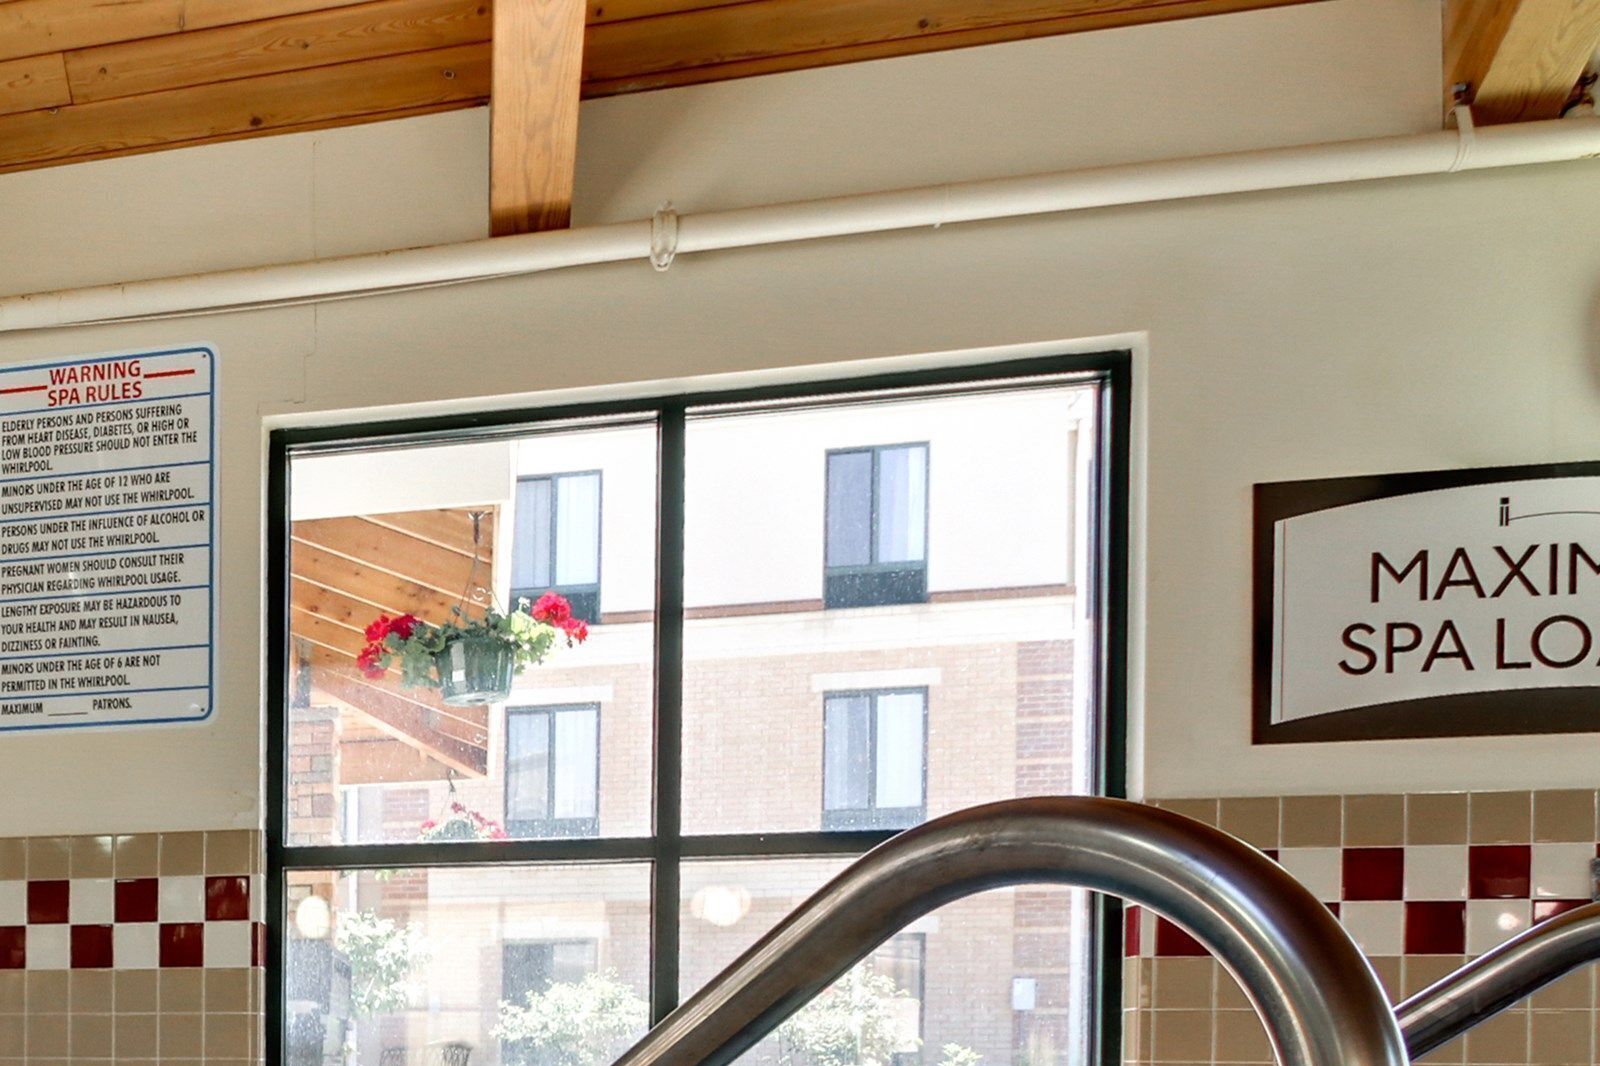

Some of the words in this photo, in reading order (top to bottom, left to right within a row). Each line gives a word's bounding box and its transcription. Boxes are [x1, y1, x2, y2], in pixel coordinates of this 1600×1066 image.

[50, 360, 141, 385] WARNING
[48, 388, 80, 407] SPA
[86, 381, 142, 402] RULES
[2, 419, 35, 433] ELDERLY
[37, 416, 74, 430] PERSONS
[76, 413, 94, 425] AND
[96, 410, 133, 424] PERSONS
[136, 405, 182, 419] SUFFERING
[2, 435, 25, 446] FROM
[28, 432, 53, 444] HEART
[56, 428, 90, 441] DISEASE,
[94, 424, 134, 438] DIABETES,
[137, 423, 149, 433] OR
[151, 419, 174, 432] HIGH
[177, 418, 189, 429] OR
[2, 449, 21, 461] LOW
[23, 446, 50, 458] BLOOD
[54, 441, 94, 455] PRESSURE
[96, 438, 130, 451] SHOULD
[133, 437, 150, 448] NOT
[153, 434, 178, 446] ENTER
[181, 431, 197, 443] THE
[2, 460, 53, 474] WHIRLPOOL.
[2, 484, 34, 497] MINORS
[37, 482, 65, 494] UNDER
[68, 480, 83, 491] THE
[85, 478, 101, 489] AGE
[104, 477, 115, 488] OF
[118, 476, 128, 487] 12
[131, 474, 152, 486] WHO
[154, 472, 170, 483] ARE
[2, 499, 63, 515] UNSUPERVISED
[65, 497, 83, 509] MAY
[85, 495, 101, 507] NOT
[104, 494, 120, 505] USE
[123, 493, 138, 504] THE
[141, 488, 195, 503] WHIRLPOOL.
[2, 524, 37, 538] PERSONS
[40, 522, 68, 535] UNDER
[71, 520, 86, 531] THE
[89, 516, 134, 530] INFLUENCE
[137, 515, 148, 526] OF
[151, 511, 190, 525] ALCOHOL
[192, 510, 204, 521] OR
[2, 543, 29, 555] DRUGS
[32, 541, 48, 552] MAY
[51, 539, 68, 551] NOT
[71, 538, 86, 549] USE
[88, 536, 104, 547] THE
[106, 532, 159, 546] WHIRLPOOL.
[1, 564, 45, 577] PREGNANT
[47, 561, 80, 574] WOMEN
[83, 558, 117, 571] SHOULD
[119, 555, 157, 568] CONSULT
[160, 553, 184, 565] THEIR
[1, 582, 44, 595] PHYSICIAN
[47, 577, 95, 591] REGARDING
[98, 573, 148, 587] WHIRLPOOL
[151, 571, 181, 584] USAGE.
[1, 604, 37, 618] LENGTHY
[40, 600, 80, 615] EXPOSURE
[83, 599, 100, 611] MAY
[103, 599, 113, 610] BE
[116, 596, 168, 609] HAZARDOUS
[170, 596, 181, 606] TO
[1, 623, 23, 635] YOUR
[26, 620, 56, 633] HEALTH
[59, 619, 76, 630] AND
[79, 617, 96, 629] MAY
[99, 616, 127, 628] RESULT
[130, 615, 139, 625] IN
[142, 612, 178, 625] NAUSEA,
[1, 640, 43, 652] DIZZINESS
[45, 638, 56, 648] OR
[59, 636, 100, 648] FAINTING.
[1338, 619, 1475, 675] SPA
[1496, 614, 1600, 670] LO
[1, 662, 34, 675] MINORS
[36, 660, 65, 673] UNDER
[68, 659, 82, 670] THE
[85, 658, 101, 669] AGE
[104, 658, 115, 669] OF
[117, 657, 122, 668] 6
[125, 657, 140, 667] ARE
[143, 655, 160, 666] NOT
[1, 679, 46, 692] PERMITTED
[48, 678, 57, 689] IN
[60, 677, 75, 688] THE
[78, 674, 130, 688] WHIRLPOOL.
[1, 702, 43, 715] MAXIMUM
[93, 697, 132, 710] PATRONS.
